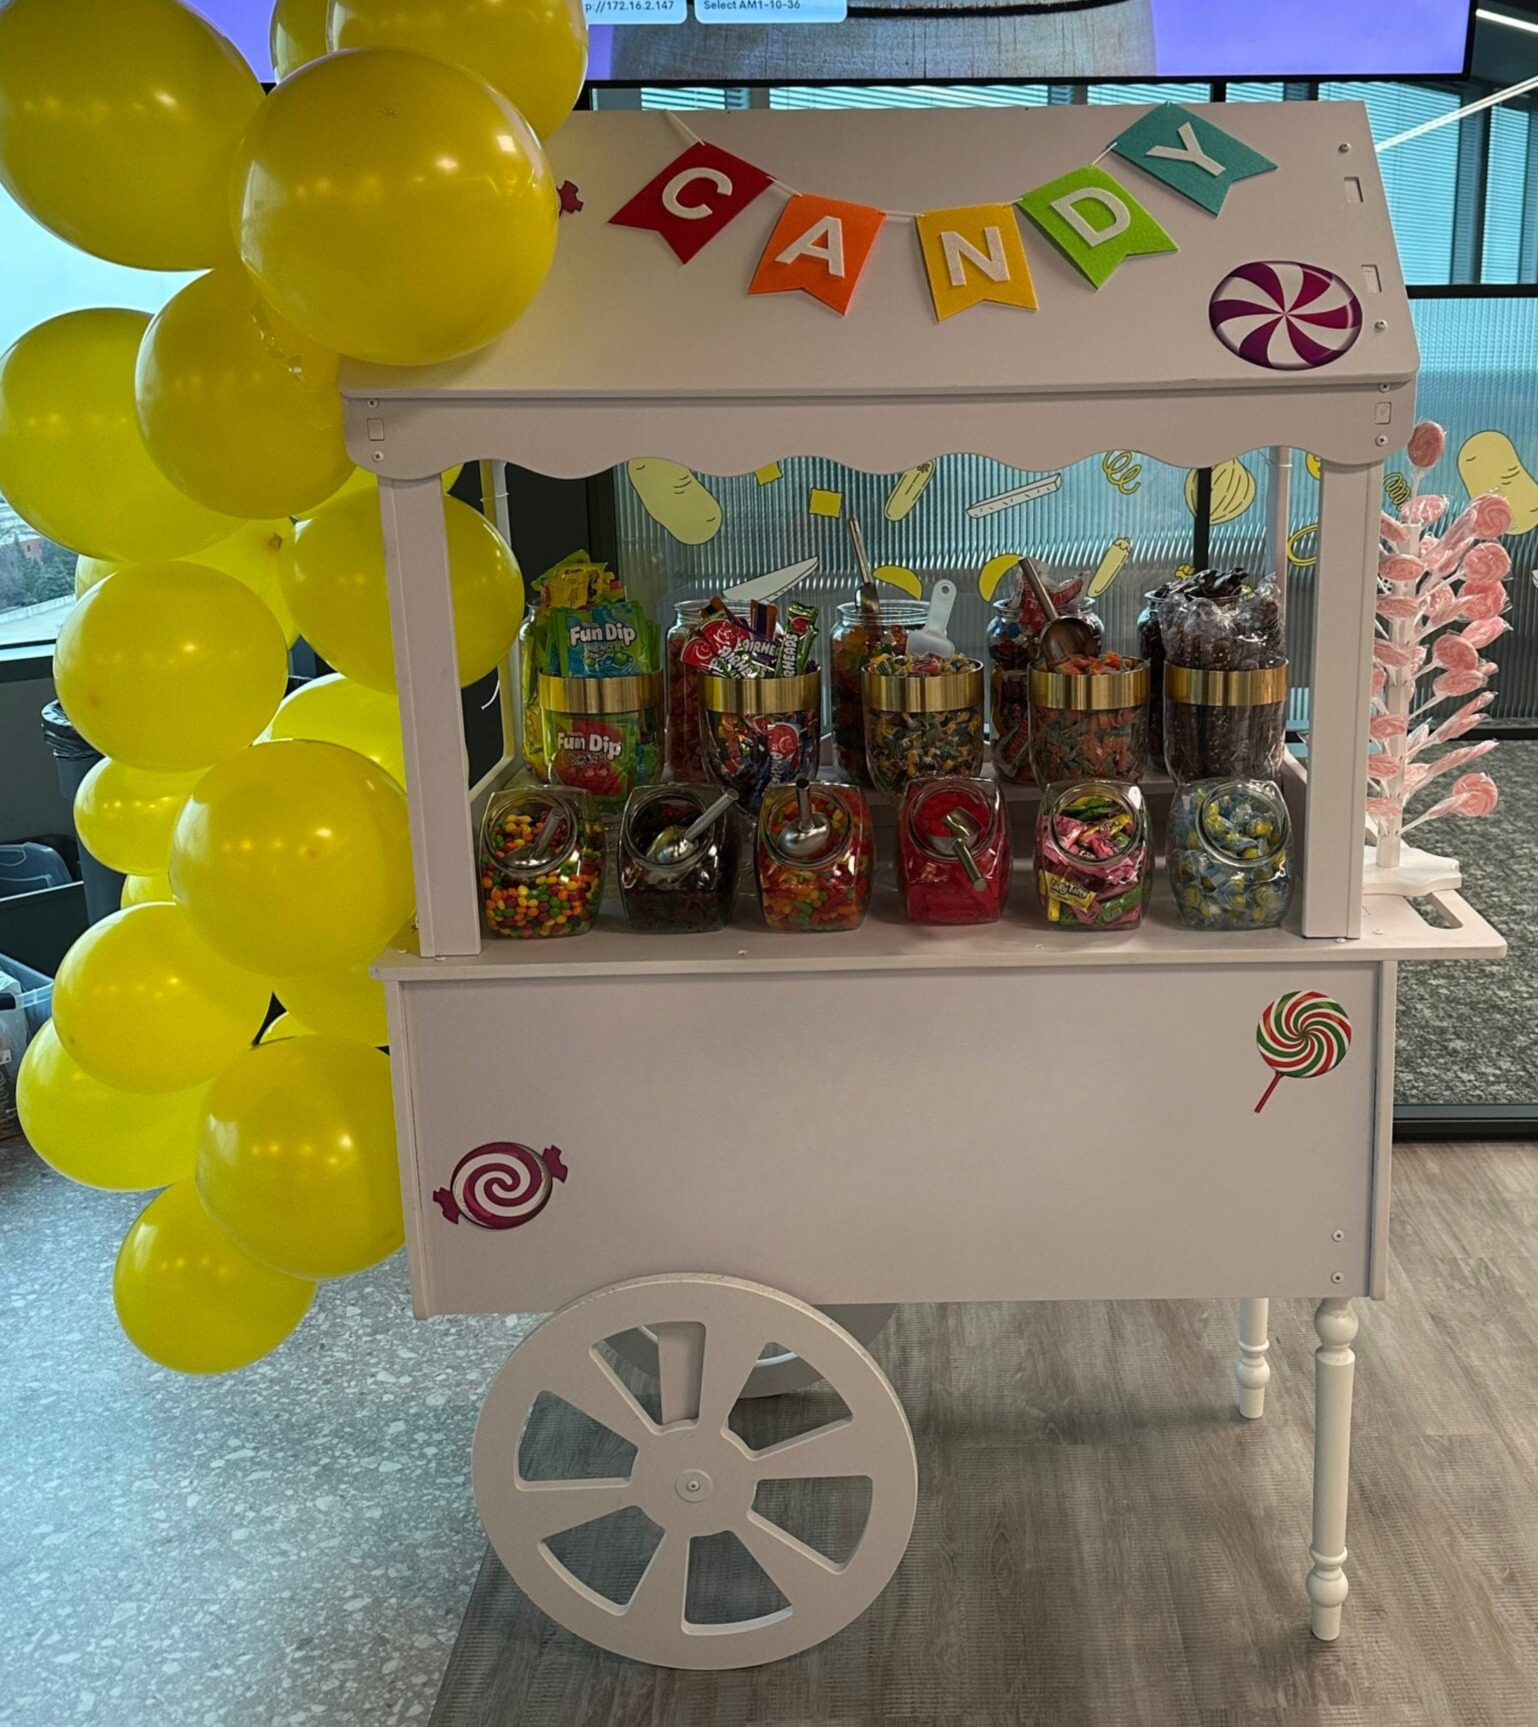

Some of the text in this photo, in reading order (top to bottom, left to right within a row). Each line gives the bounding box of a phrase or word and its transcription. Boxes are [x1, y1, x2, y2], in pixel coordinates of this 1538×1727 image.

[585, 1, 674, 13] p://172.16.2.147
[704, 0, 801, 10] Select AM1-10-36
[662, 122, 1226, 287] CANDY
[570, 623, 636, 646] Fun Dip
[742, 639, 777, 657] AIRHE
[781, 633, 799, 678] RHEADS
[557, 732, 585, 750] Fun
[589, 733, 622, 760] Dip
